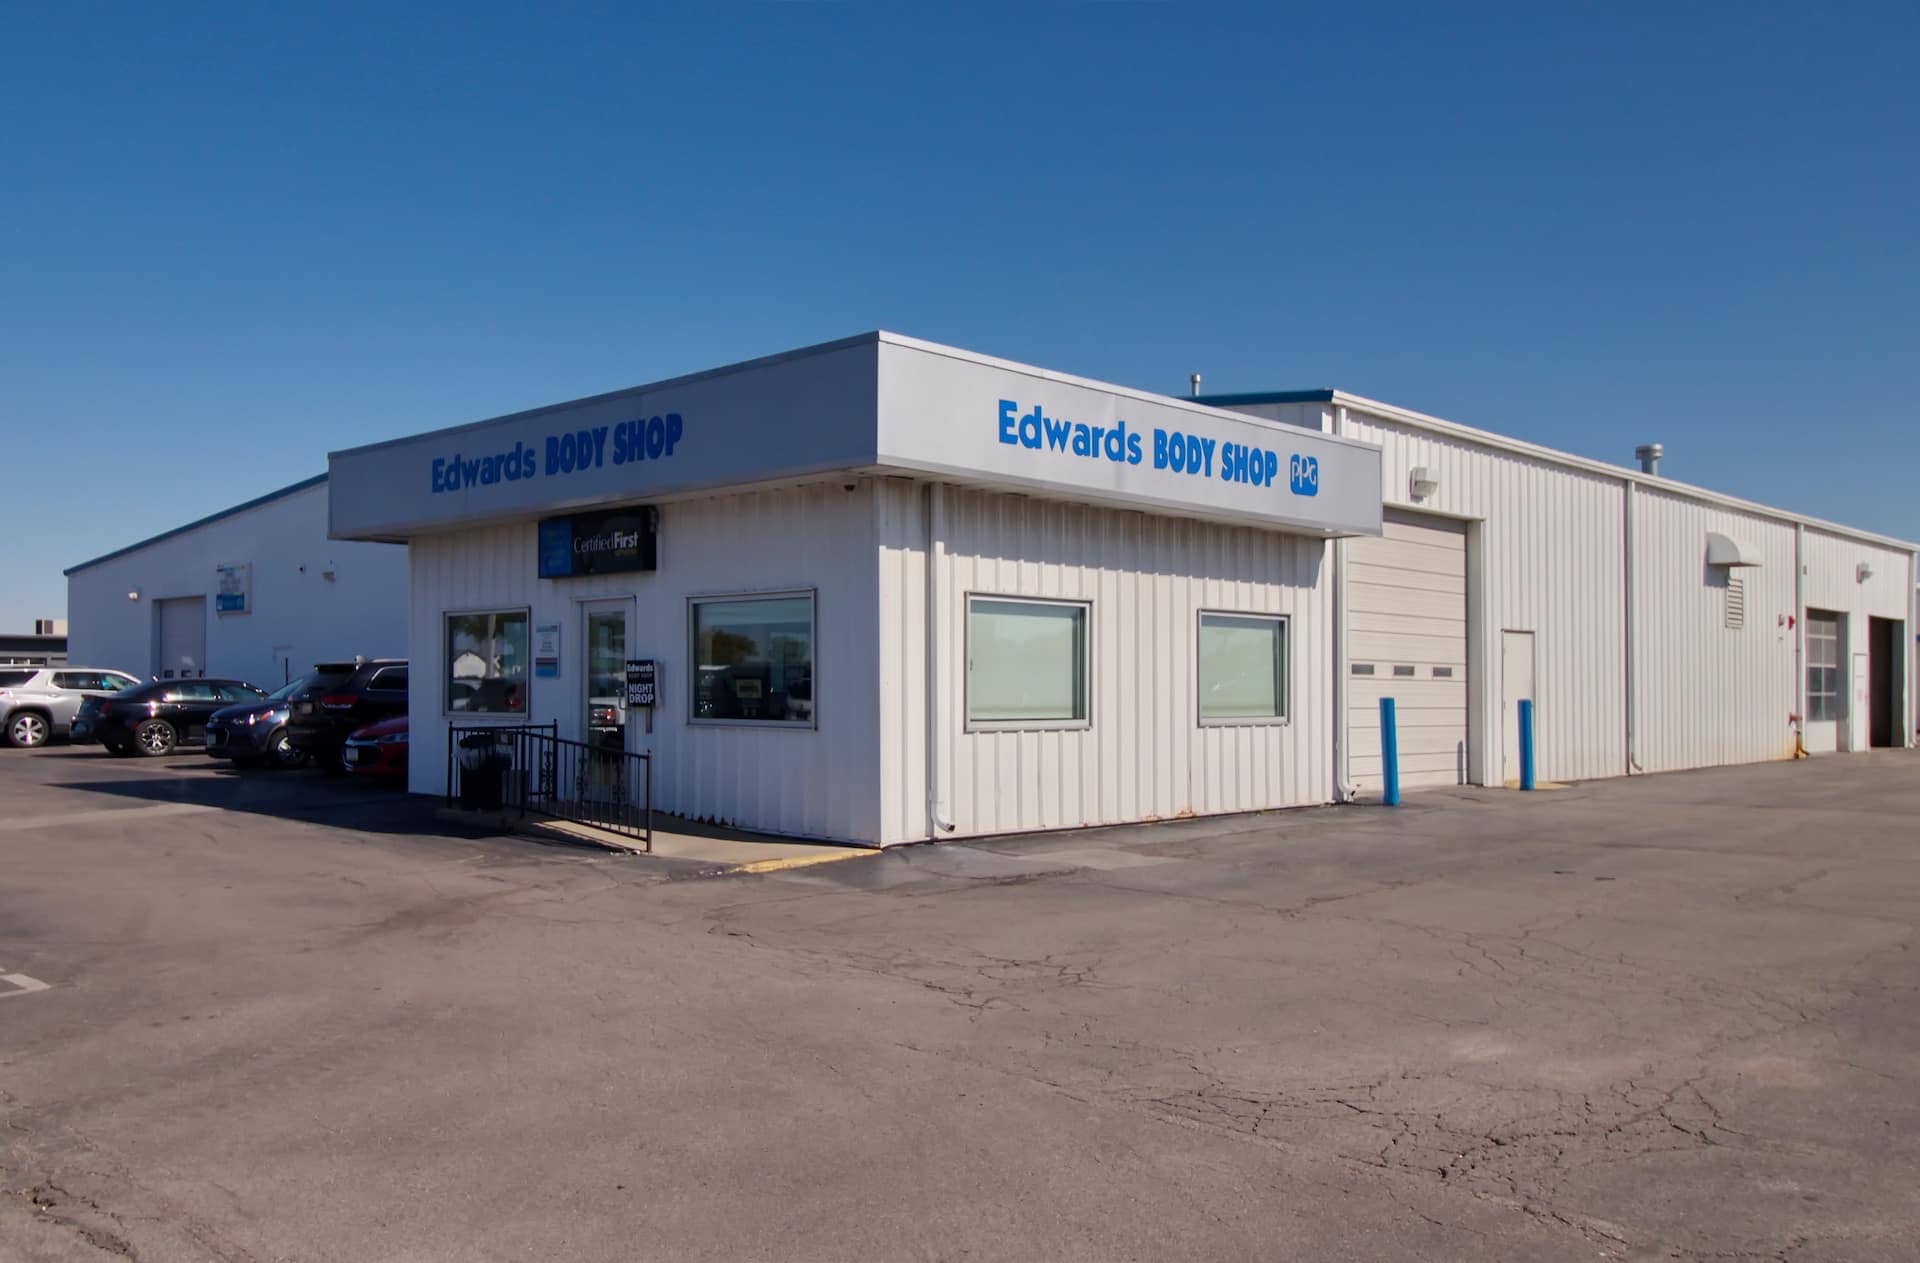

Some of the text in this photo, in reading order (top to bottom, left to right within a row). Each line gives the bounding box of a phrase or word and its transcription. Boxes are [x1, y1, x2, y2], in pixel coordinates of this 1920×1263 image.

[431, 413, 683, 493] Edwards BODY SHOP
[999, 399, 1277, 488] Edwards BODY SHOP
[1290, 455, 1318, 490] PPG
[629, 683, 654, 693] NIGHT
[629, 693, 655, 704] DROP
